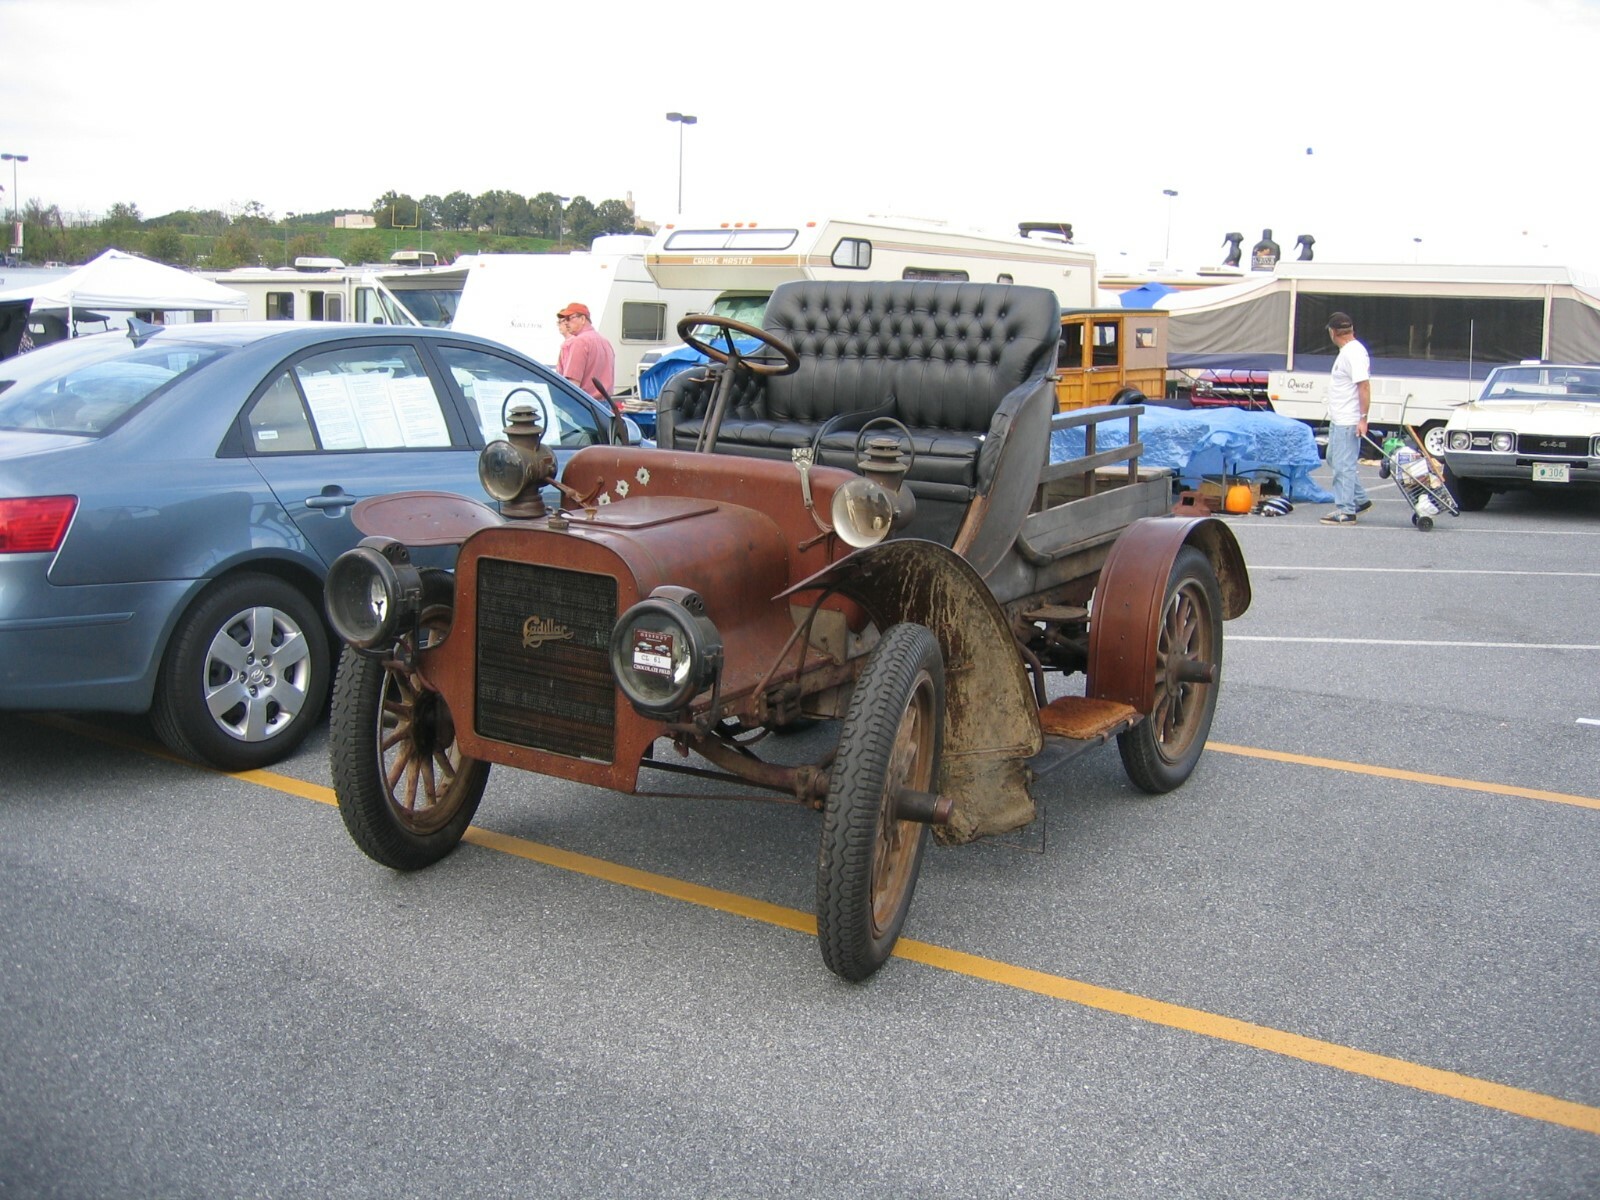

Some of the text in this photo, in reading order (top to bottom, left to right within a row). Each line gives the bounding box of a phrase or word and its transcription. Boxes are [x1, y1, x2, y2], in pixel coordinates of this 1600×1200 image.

[692, 256, 753, 265] CRUISE MASTER
[522, 614, 575, 649] Cadillac
